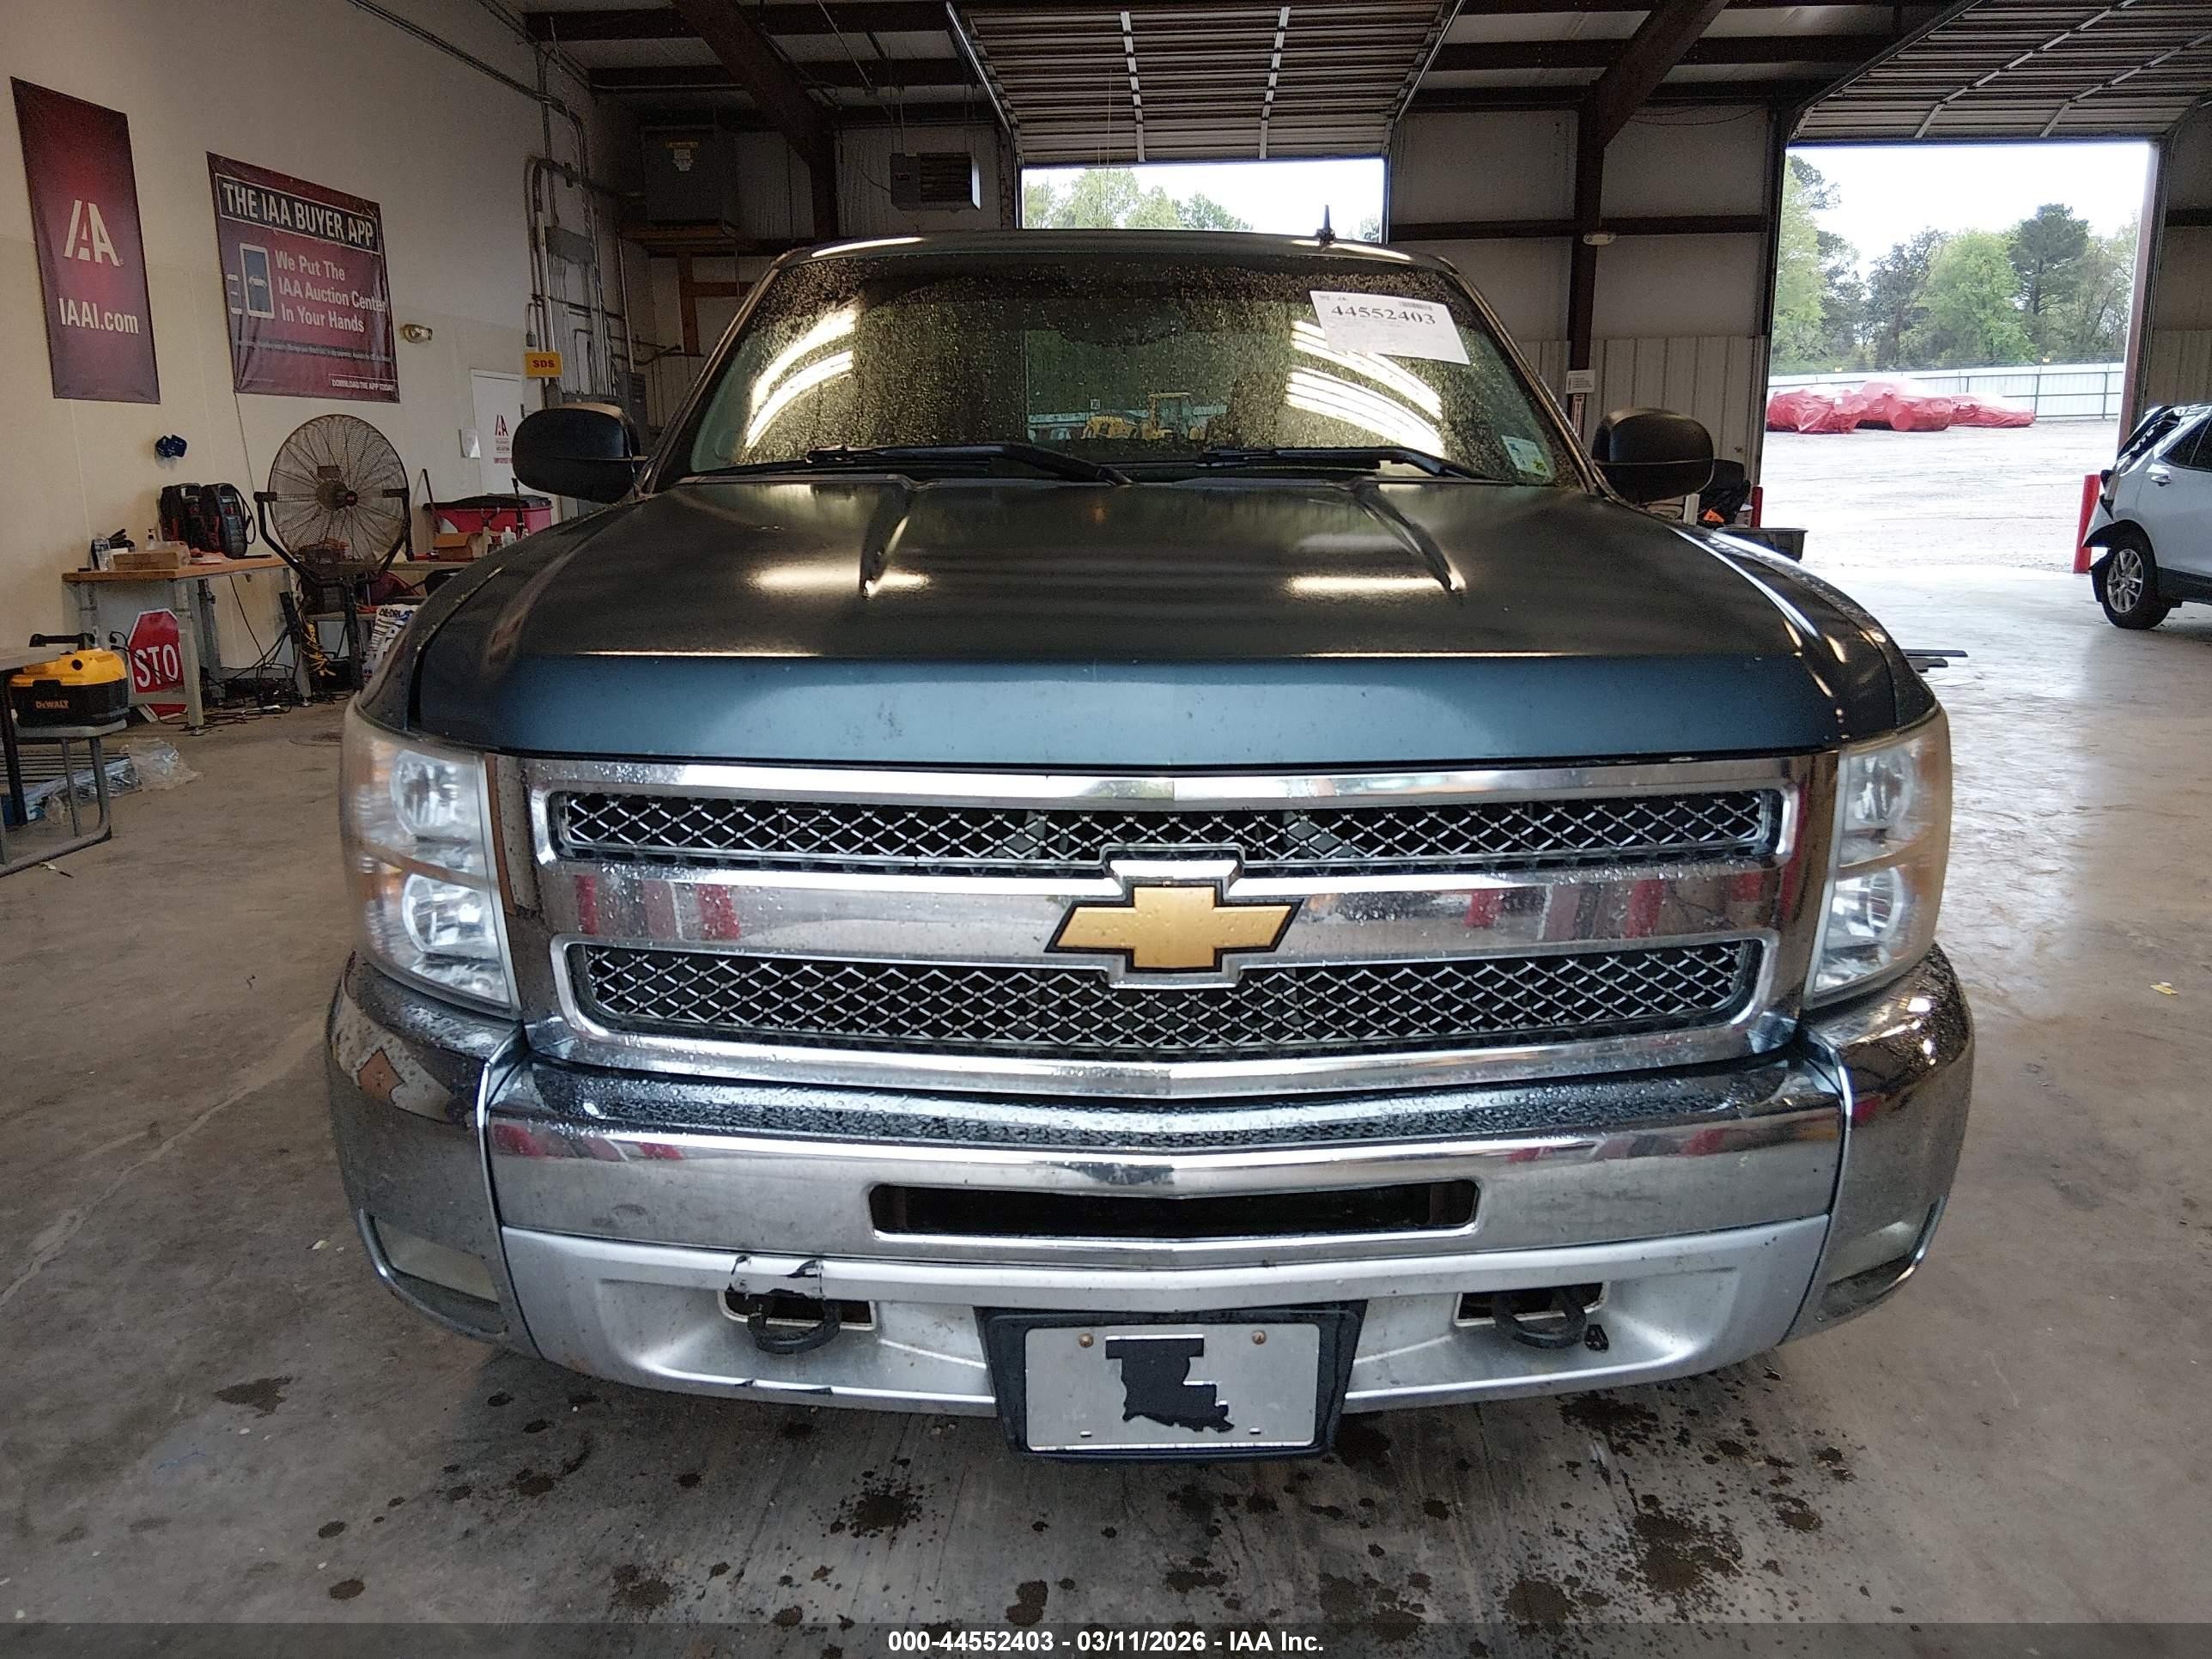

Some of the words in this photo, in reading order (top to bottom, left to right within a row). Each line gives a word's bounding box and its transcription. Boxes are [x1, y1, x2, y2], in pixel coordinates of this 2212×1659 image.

[223, 182, 258, 218] THE
[261, 193, 292, 227] IAA
[295, 202, 345, 240] BUYER
[348, 217, 374, 246] APP
[275, 250, 295, 270] We
[300, 255, 321, 277] Put
[324, 260, 346, 282] The
[277, 276, 303, 299] IAA
[305, 281, 350, 307] Auction
[351, 290, 386, 313] Center
[58, 297, 139, 334] IAAI.com
[281, 302, 295, 323] In
[296, 306, 325, 327] Your
[328, 310, 365, 333] Hands
[1331, 305, 1436, 325] 44552403
[532, 359, 555, 368] SDS
[134, 644, 179, 688] STO
